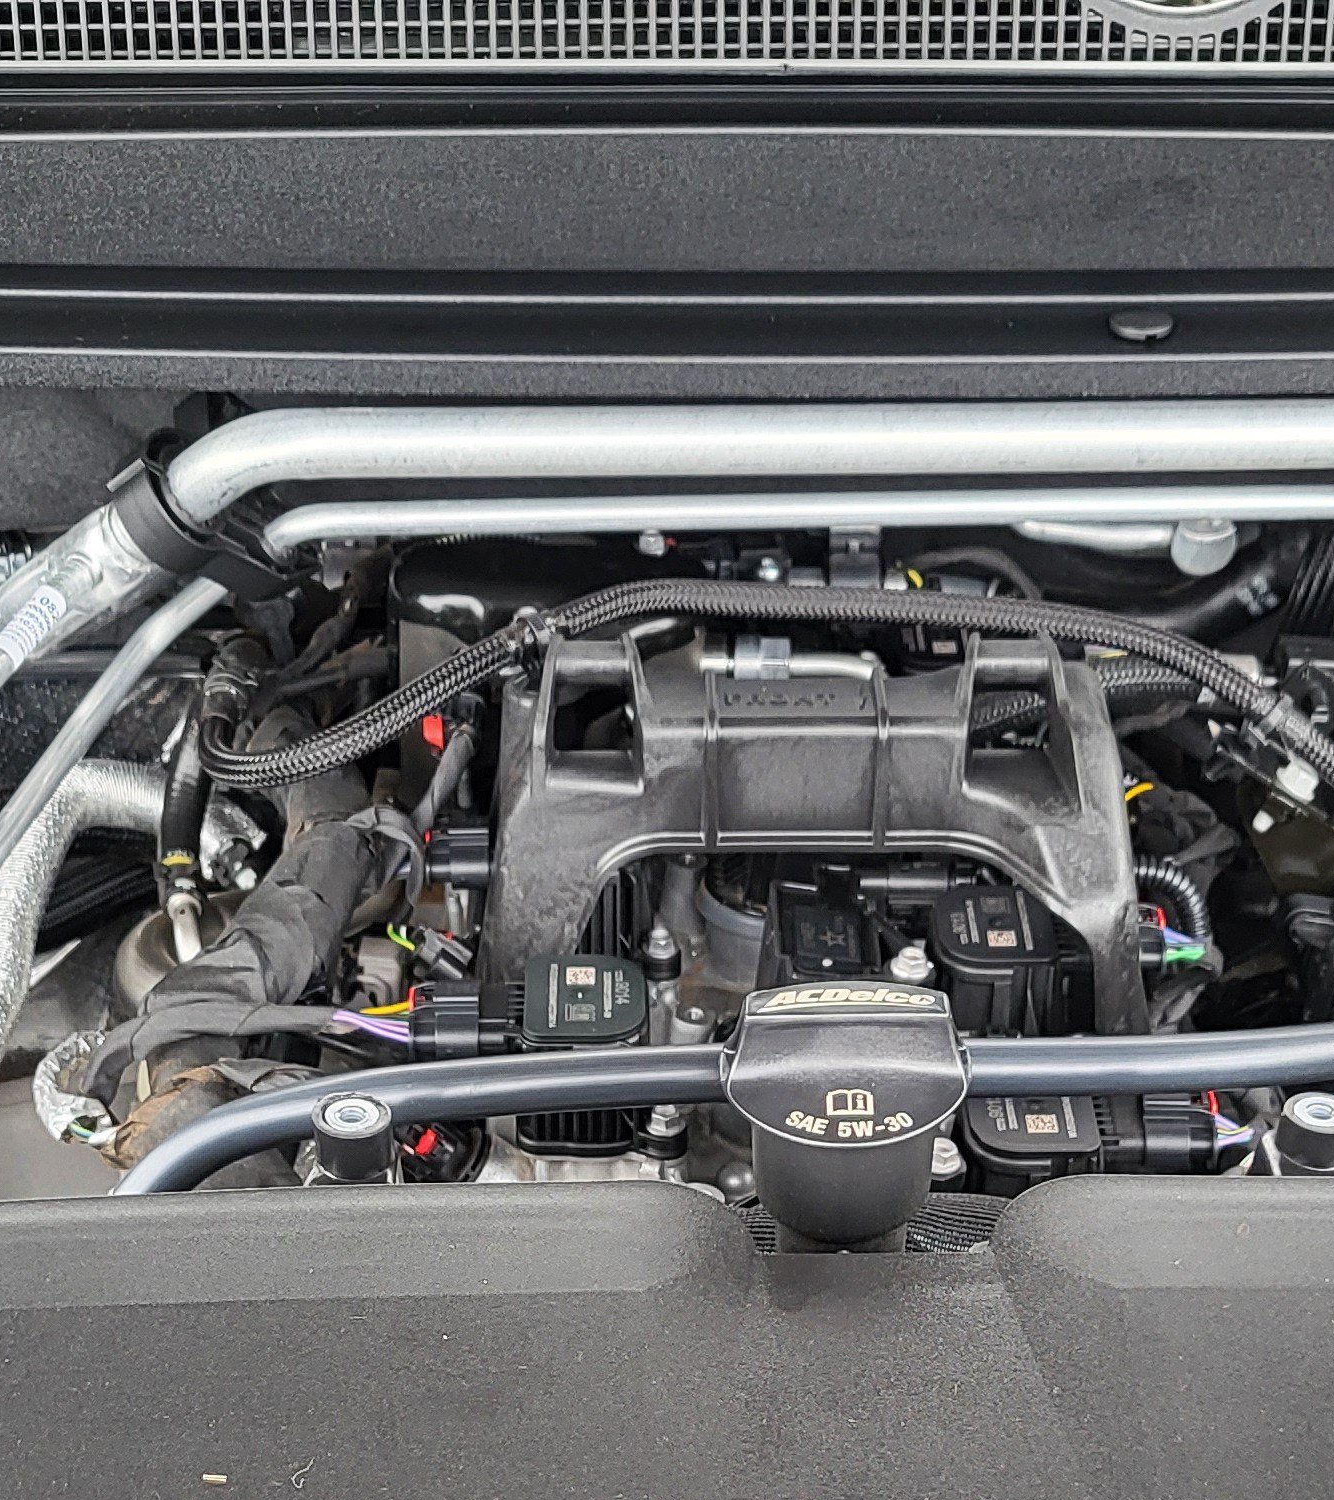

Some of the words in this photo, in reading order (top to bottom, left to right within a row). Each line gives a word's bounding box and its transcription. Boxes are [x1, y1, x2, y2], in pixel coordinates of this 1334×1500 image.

[764, 988, 937, 1008] ACDelco
[784, 1110, 830, 1136] SAE
[836, 1112, 915, 1138] 5W-30
